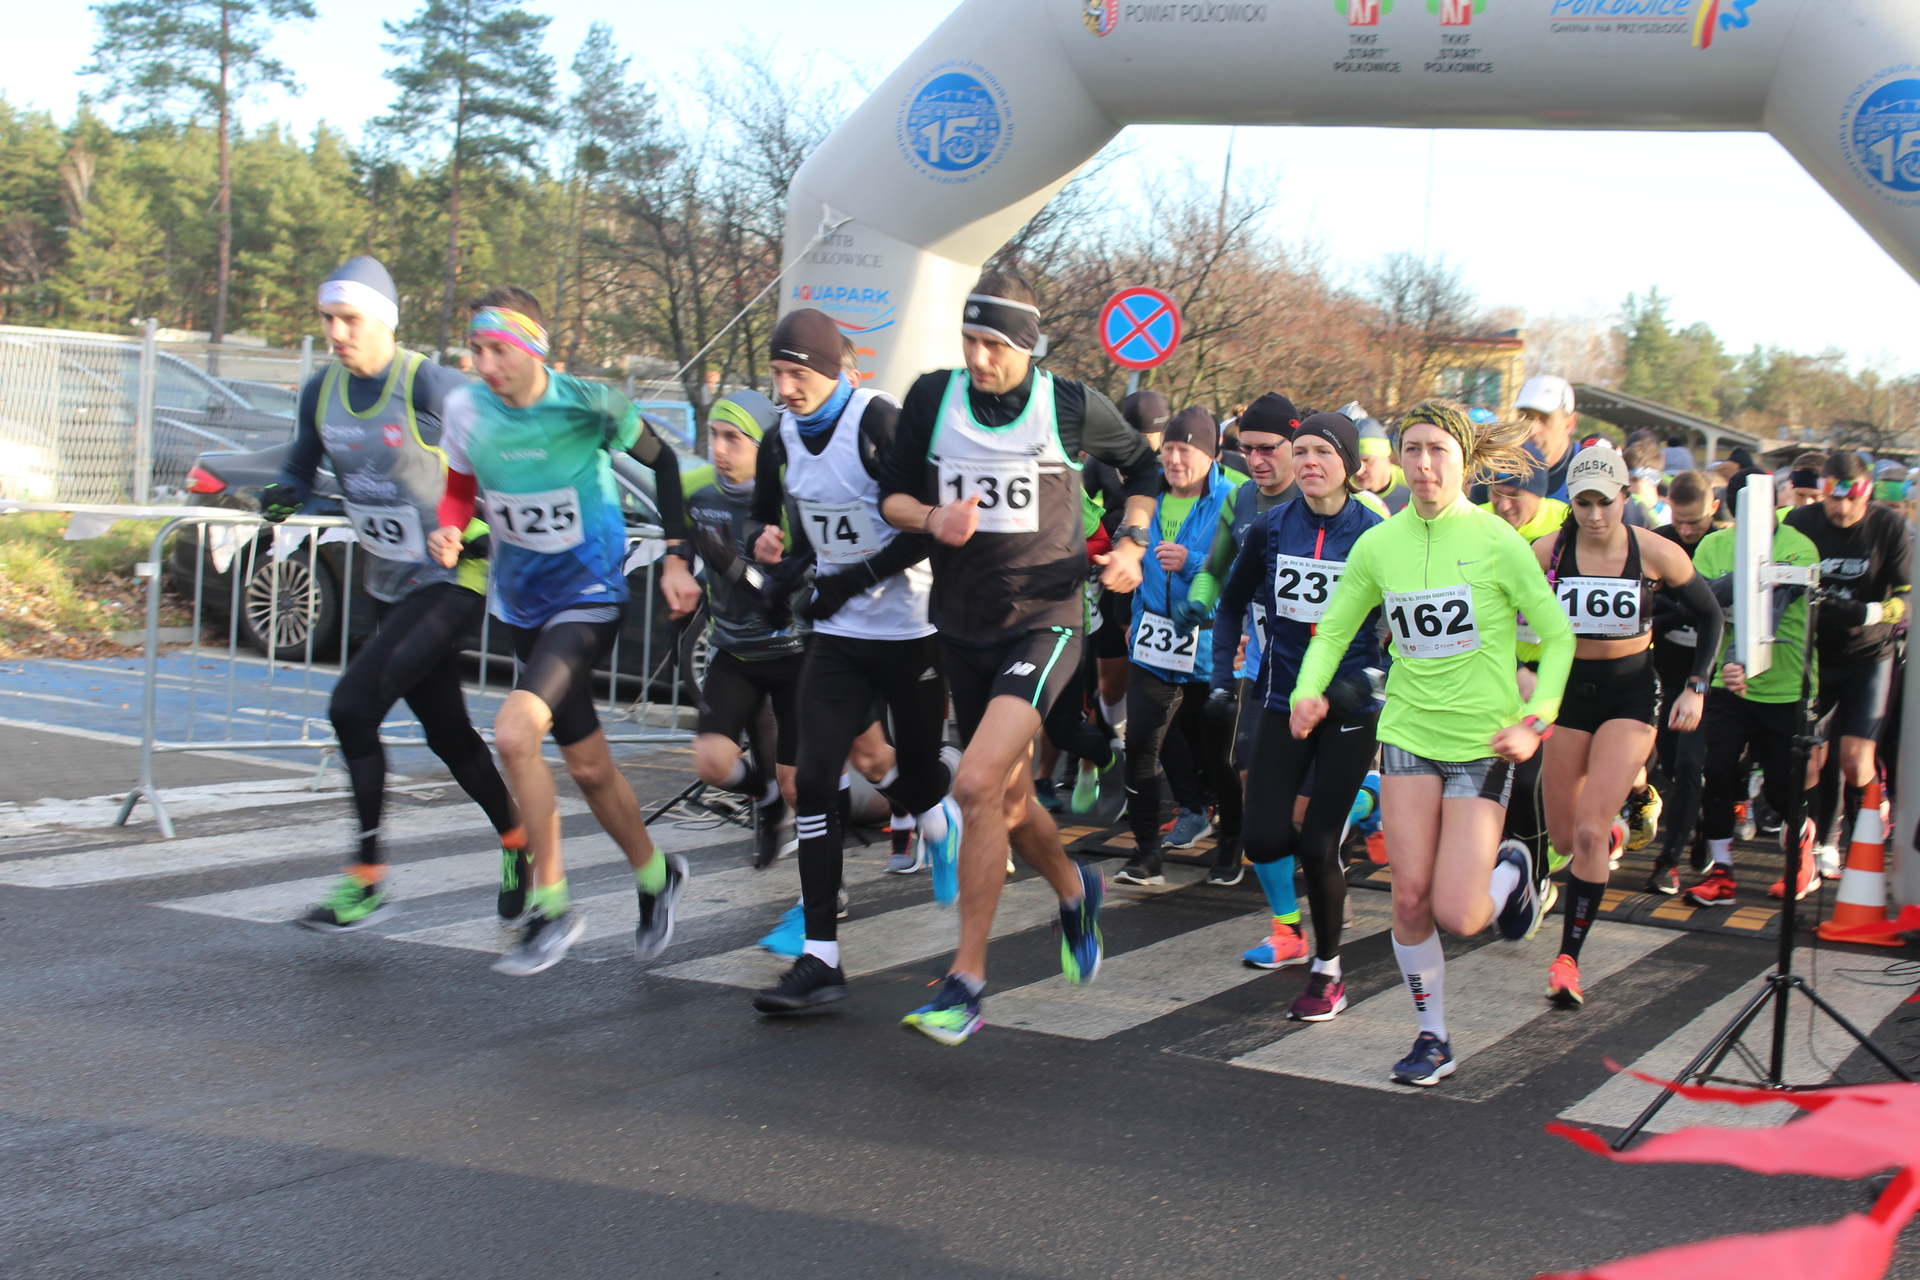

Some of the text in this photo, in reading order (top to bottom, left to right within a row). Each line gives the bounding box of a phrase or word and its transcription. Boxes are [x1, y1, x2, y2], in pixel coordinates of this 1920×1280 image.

[1125, 4, 1267, 22] POWIAT POLKOWICKI
[1333, 62, 1401, 73] POLKOWICE
[1424, 62, 1494, 73] POLKOWICE
[919, 115, 980, 164] 15
[792, 285, 891, 305] AQUAPARK
[1572, 460, 1614, 478] POLSKA
[946, 475, 1032, 509] 136
[363, 516, 405, 545] 49
[494, 502, 575, 534] 125
[812, 515, 860, 544] 74
[1277, 568, 1345, 604] 23
[1561, 588, 1636, 619] 166
[1391, 599, 1474, 639] 162
[1137, 623, 1195, 657] 232
